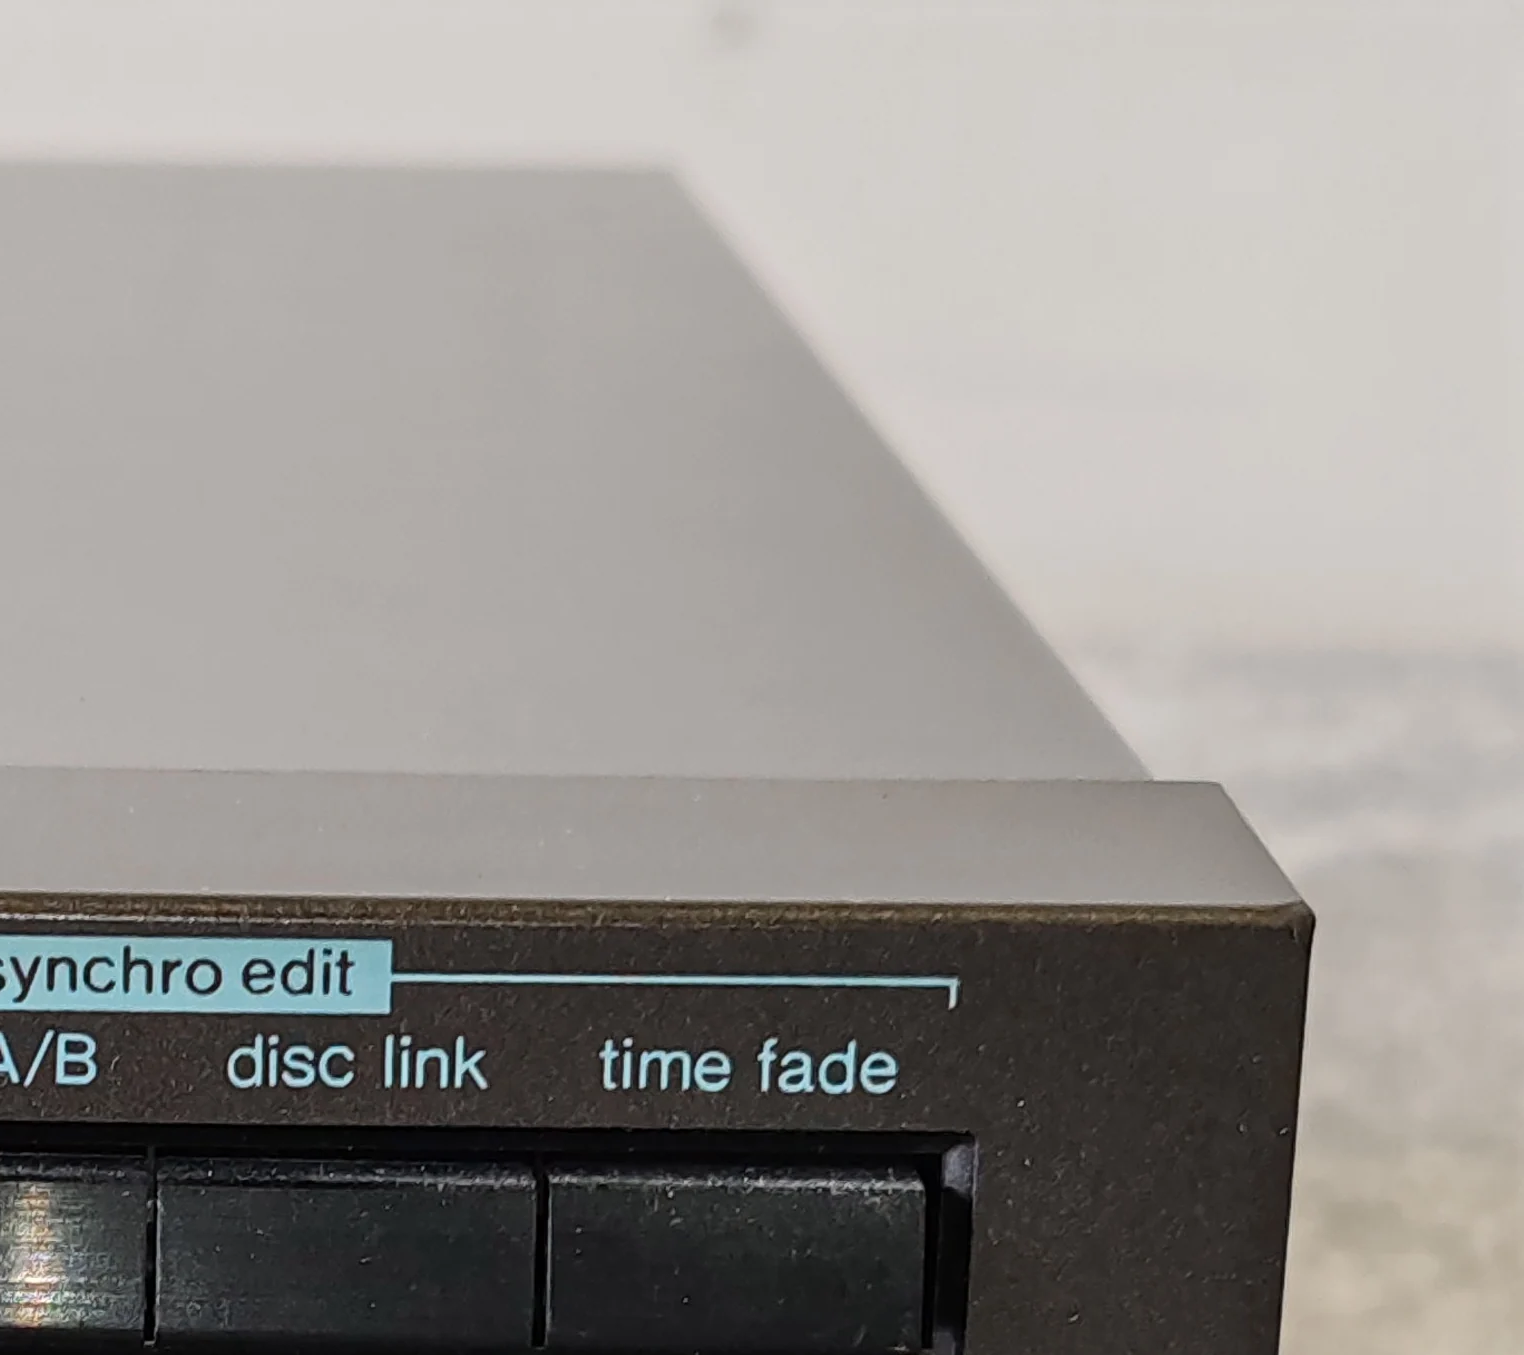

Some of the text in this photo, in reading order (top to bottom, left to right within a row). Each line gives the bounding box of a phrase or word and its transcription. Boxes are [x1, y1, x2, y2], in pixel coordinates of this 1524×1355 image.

[241, 947, 355, 997] edit
[227, 1033, 488, 1090] disc link
[599, 1037, 898, 1095] time fade
